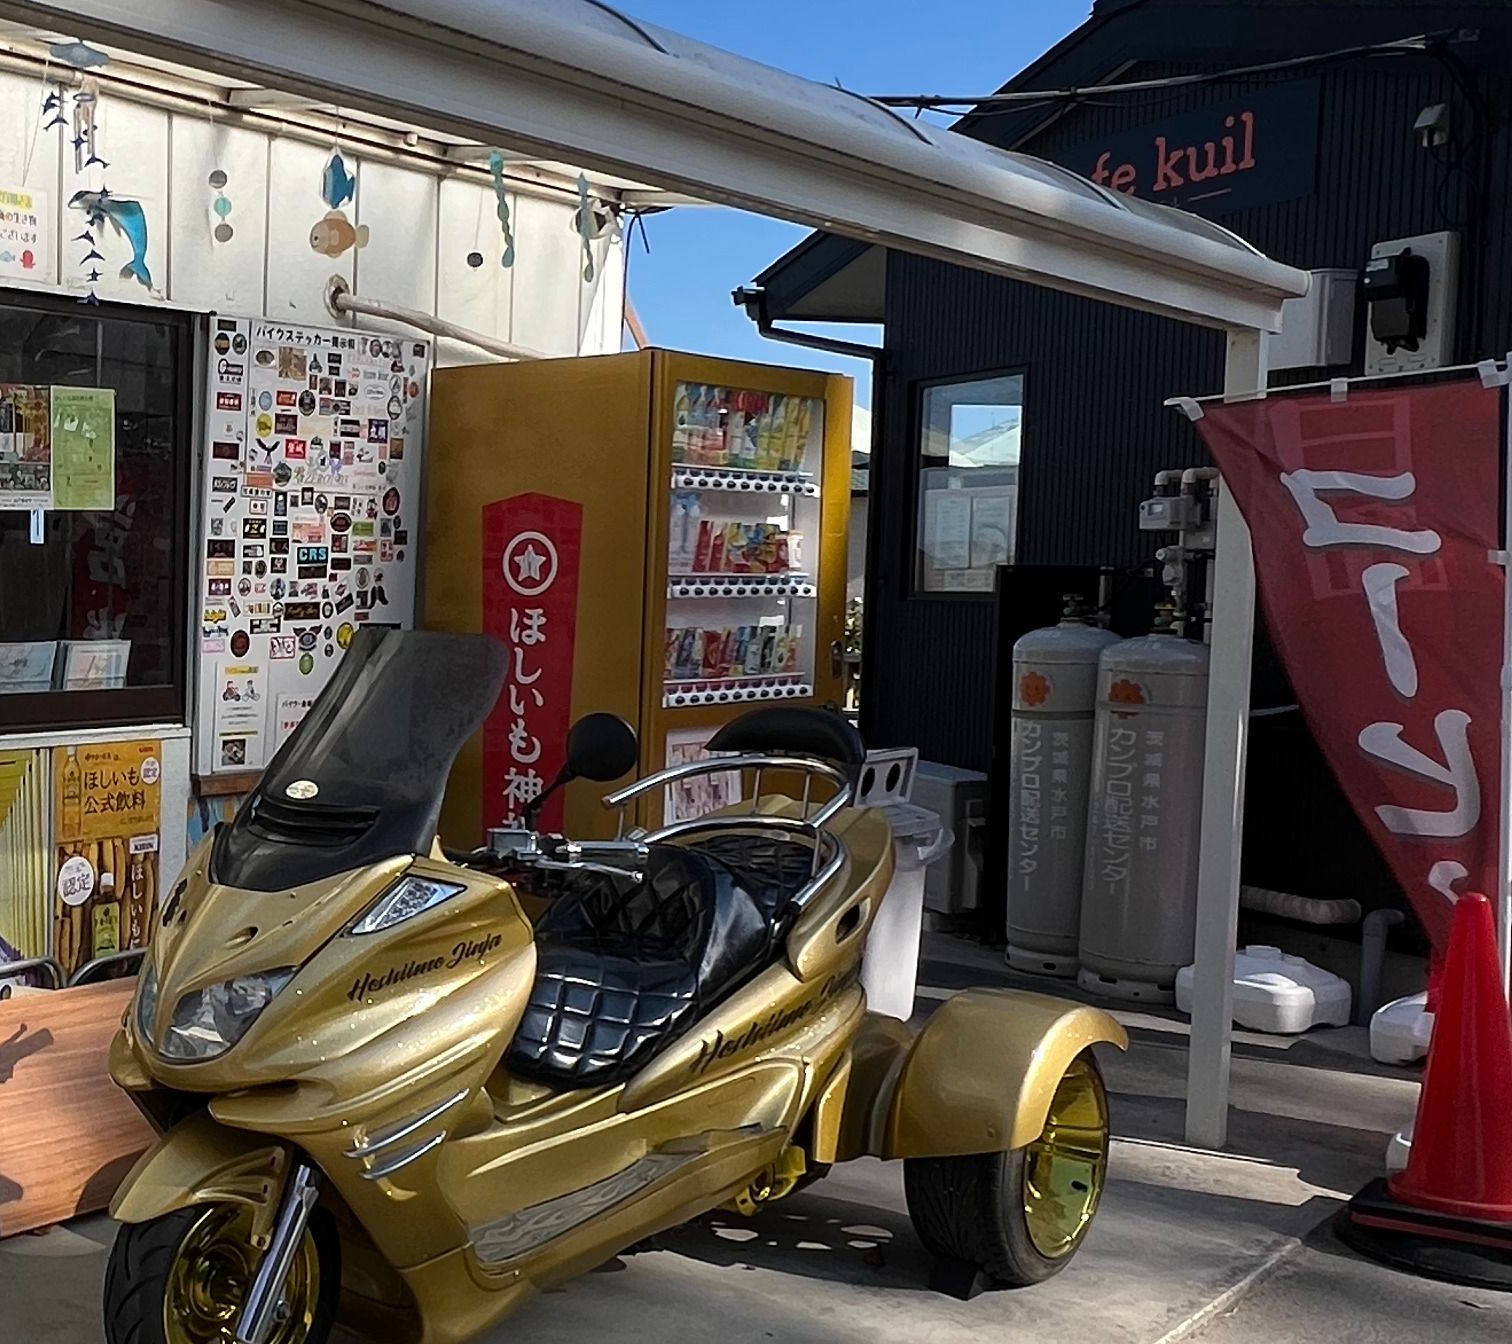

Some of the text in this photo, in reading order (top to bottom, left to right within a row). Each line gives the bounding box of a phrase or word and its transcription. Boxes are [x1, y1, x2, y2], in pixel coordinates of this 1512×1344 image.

[1152, 111, 1256, 192] kuil
[299, 547, 327, 561] CRS
[84, 767, 140, 790] ほしいも
[84, 789, 146, 815] 公式飲料
[347, 956, 445, 1002] Hoshiimo
